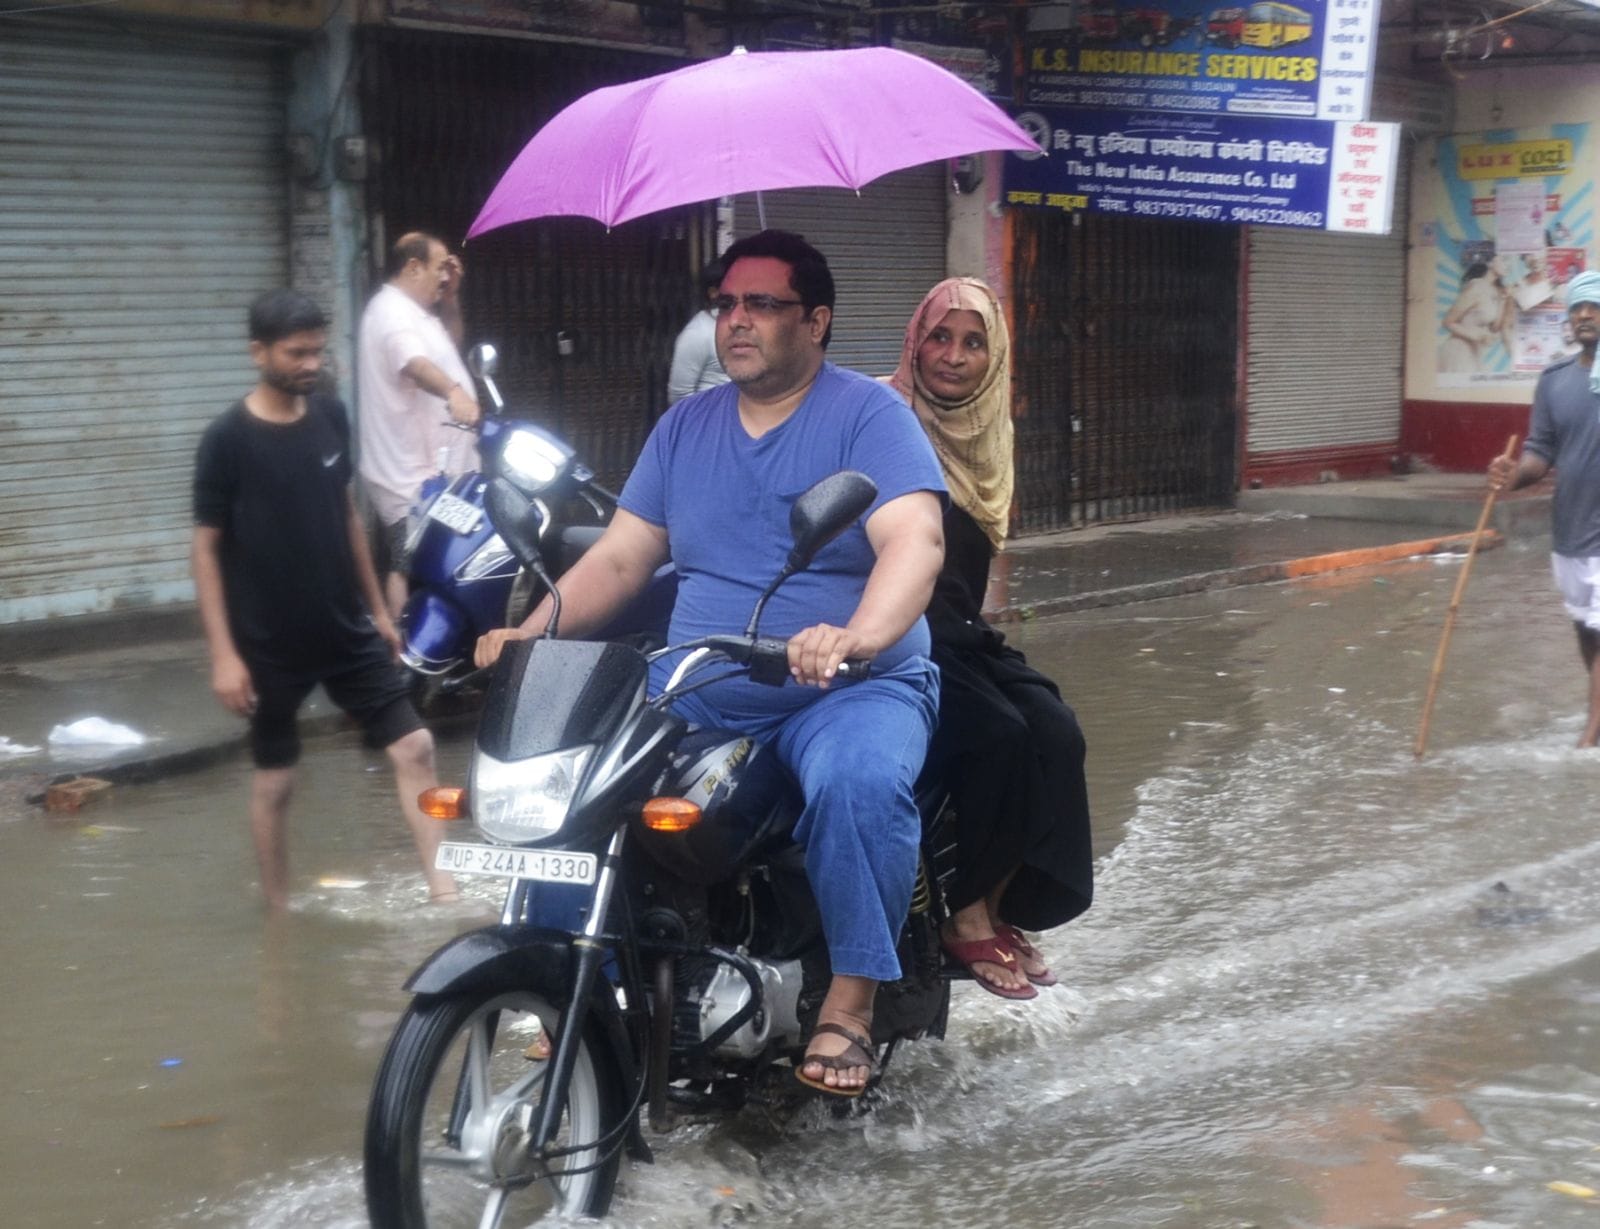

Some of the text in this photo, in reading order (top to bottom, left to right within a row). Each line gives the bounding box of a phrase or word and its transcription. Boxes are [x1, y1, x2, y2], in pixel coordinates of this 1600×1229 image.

[1079, 49, 1200, 76] INSURANCE
[1206, 54, 1318, 81] SERVICES
[1066, 160, 1297, 189] The New India Assurance Co. Ltd
[1133, 200, 1227, 221] 9837937467,
[1230, 207, 1323, 226] 9045220862
[453, 848, 589, 879] UP 24AA 1330
